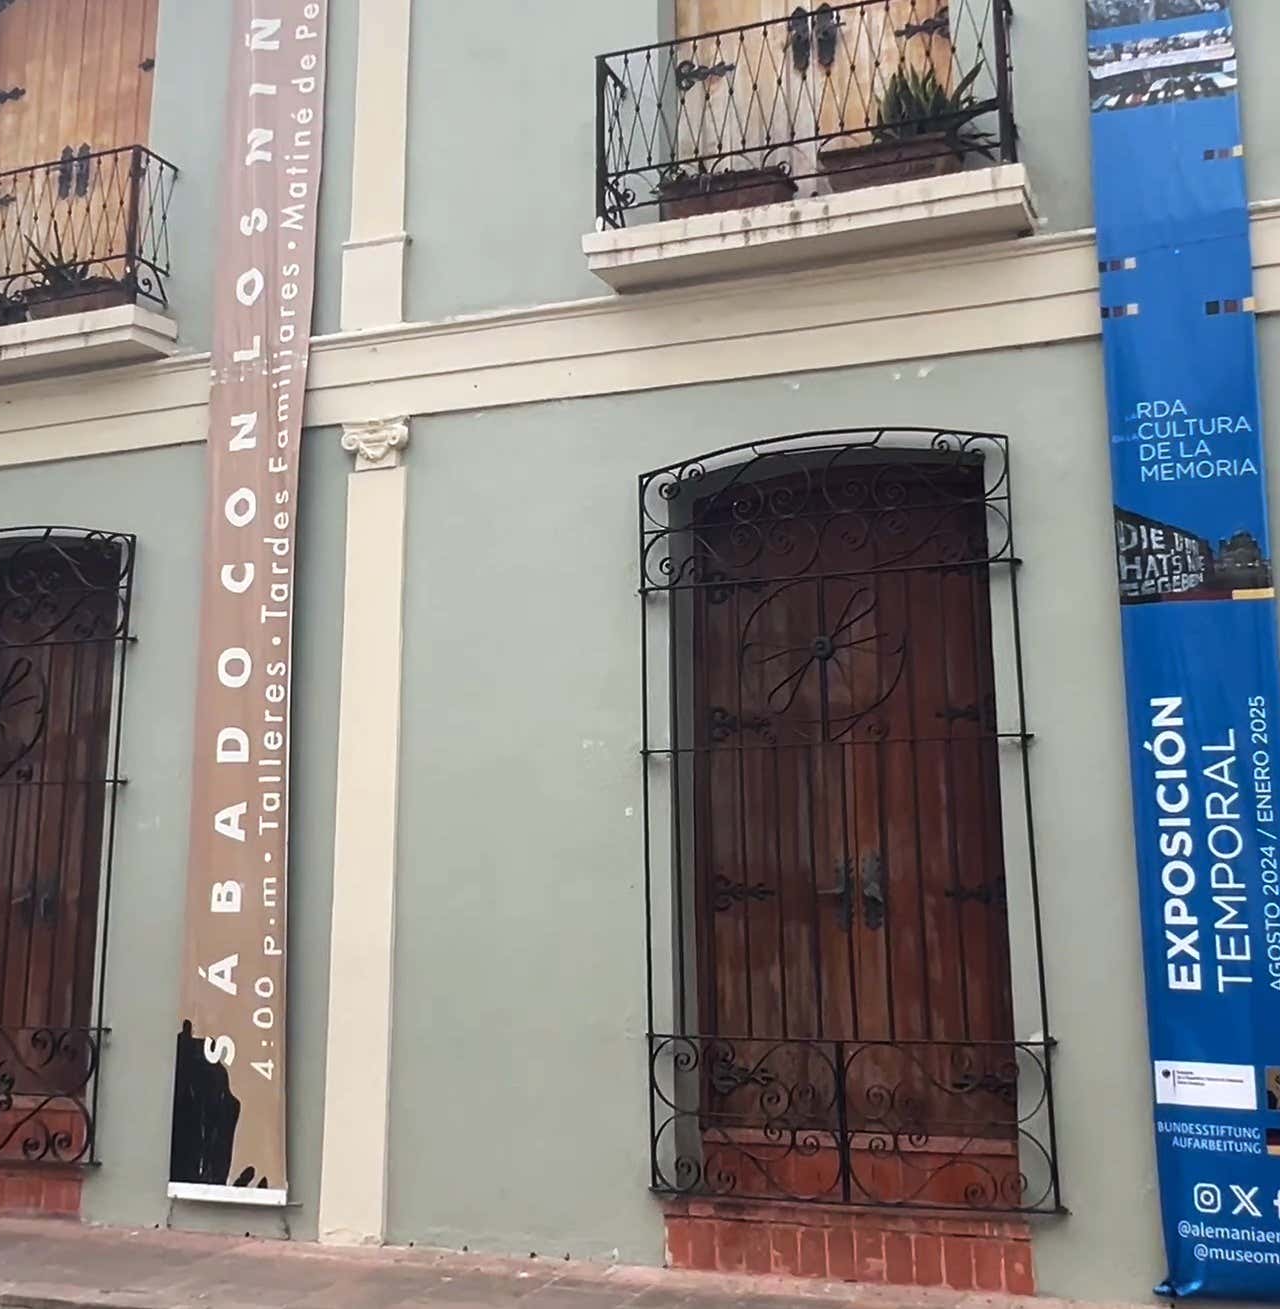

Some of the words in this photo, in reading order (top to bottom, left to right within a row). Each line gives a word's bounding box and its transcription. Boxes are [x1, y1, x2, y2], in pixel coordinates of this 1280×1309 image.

[291, 54, 316, 93] de
[279, 108, 313, 231] Matiné
[233, 208, 268, 362] LOS
[269, 264, 299, 473] Familiares
[1137, 400, 1188, 419] RDA
[1138, 416, 1252, 440] CULTURA
[1140, 442, 1171, 461] DE
[1179, 440, 1212, 458] LA
[1141, 458, 1258, 482] MEMORIA
[221, 411, 258, 593] CON
[260, 490, 290, 622] Tardes
[259, 662, 286, 835] Talleres
[1248, 696, 1266, 745] 2025
[1253, 751, 1272, 824] ENERO
[198, 646, 253, 1066] SÁBADO
[1144, 697, 1202, 992] EXPOSICIÓN
[1202, 728, 1253, 993] TEMPORAL
[1262, 846, 1278, 897] 2024
[250, 976, 274, 1080] 4:00
[1156, 1120, 1262, 1140] BUNDESSTIFTUNG
[1171, 1136, 1263, 1155] AUFARBEITUNG
